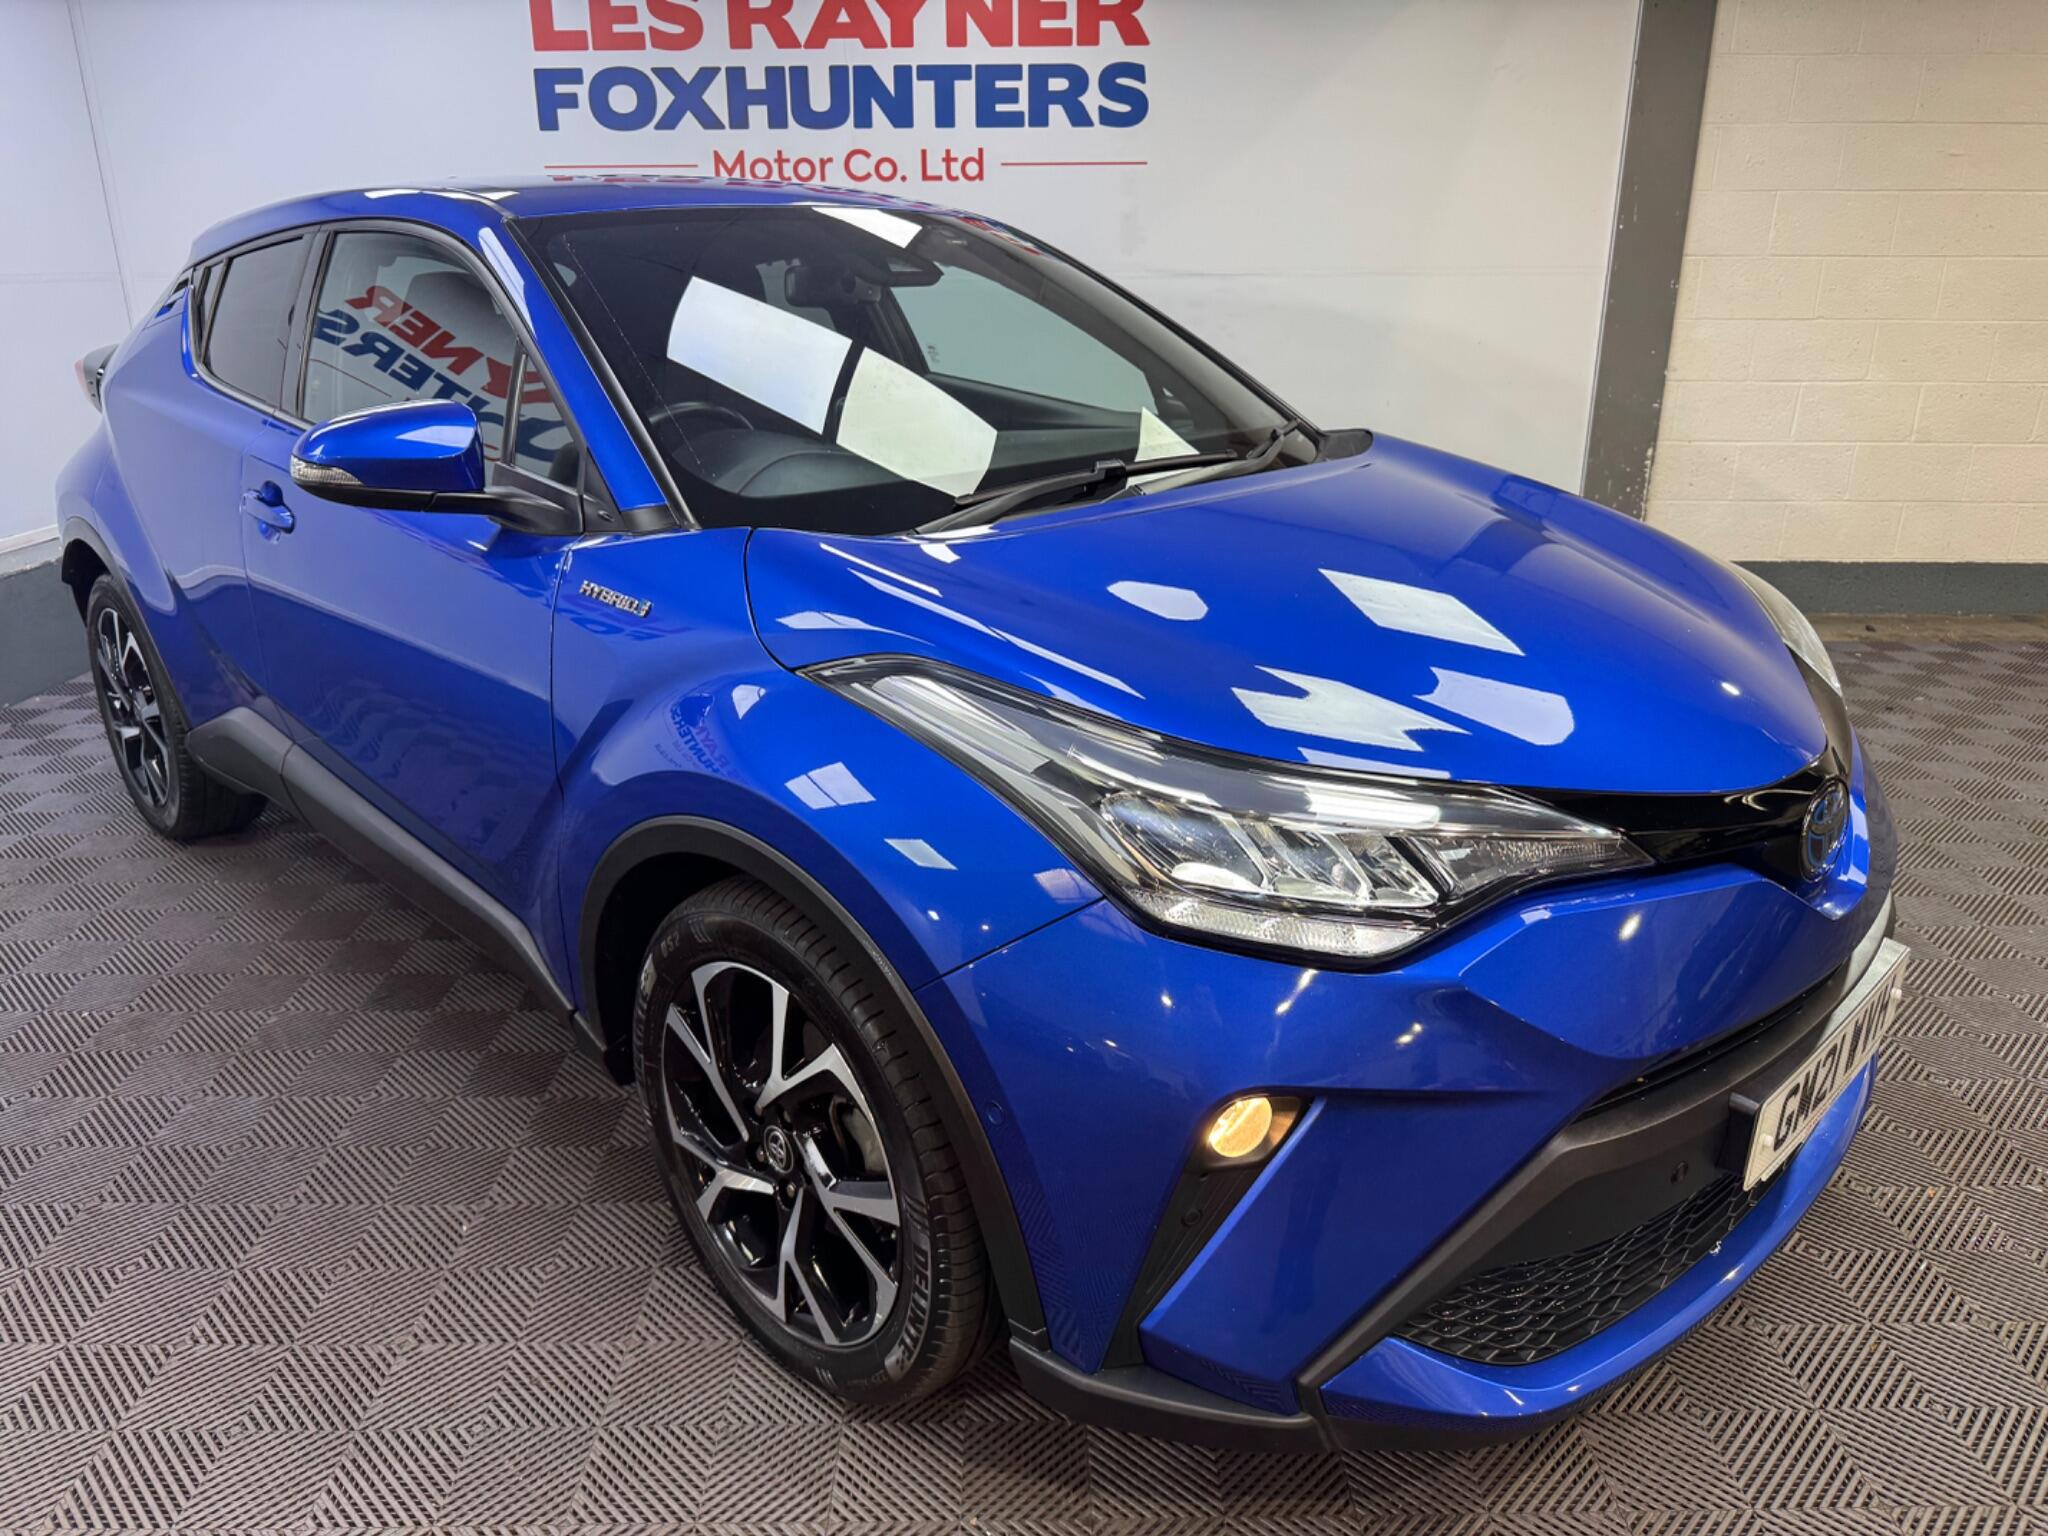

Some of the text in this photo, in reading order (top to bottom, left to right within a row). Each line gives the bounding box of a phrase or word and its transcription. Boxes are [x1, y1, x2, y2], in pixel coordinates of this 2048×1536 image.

[528, 0, 1150, 52] LES RAYNER
[533, 61, 1150, 132] FOXHUNTERS
[713, 147, 985, 183] Motor Co. Ltd
[579, 580, 640, 613] HYBRID
